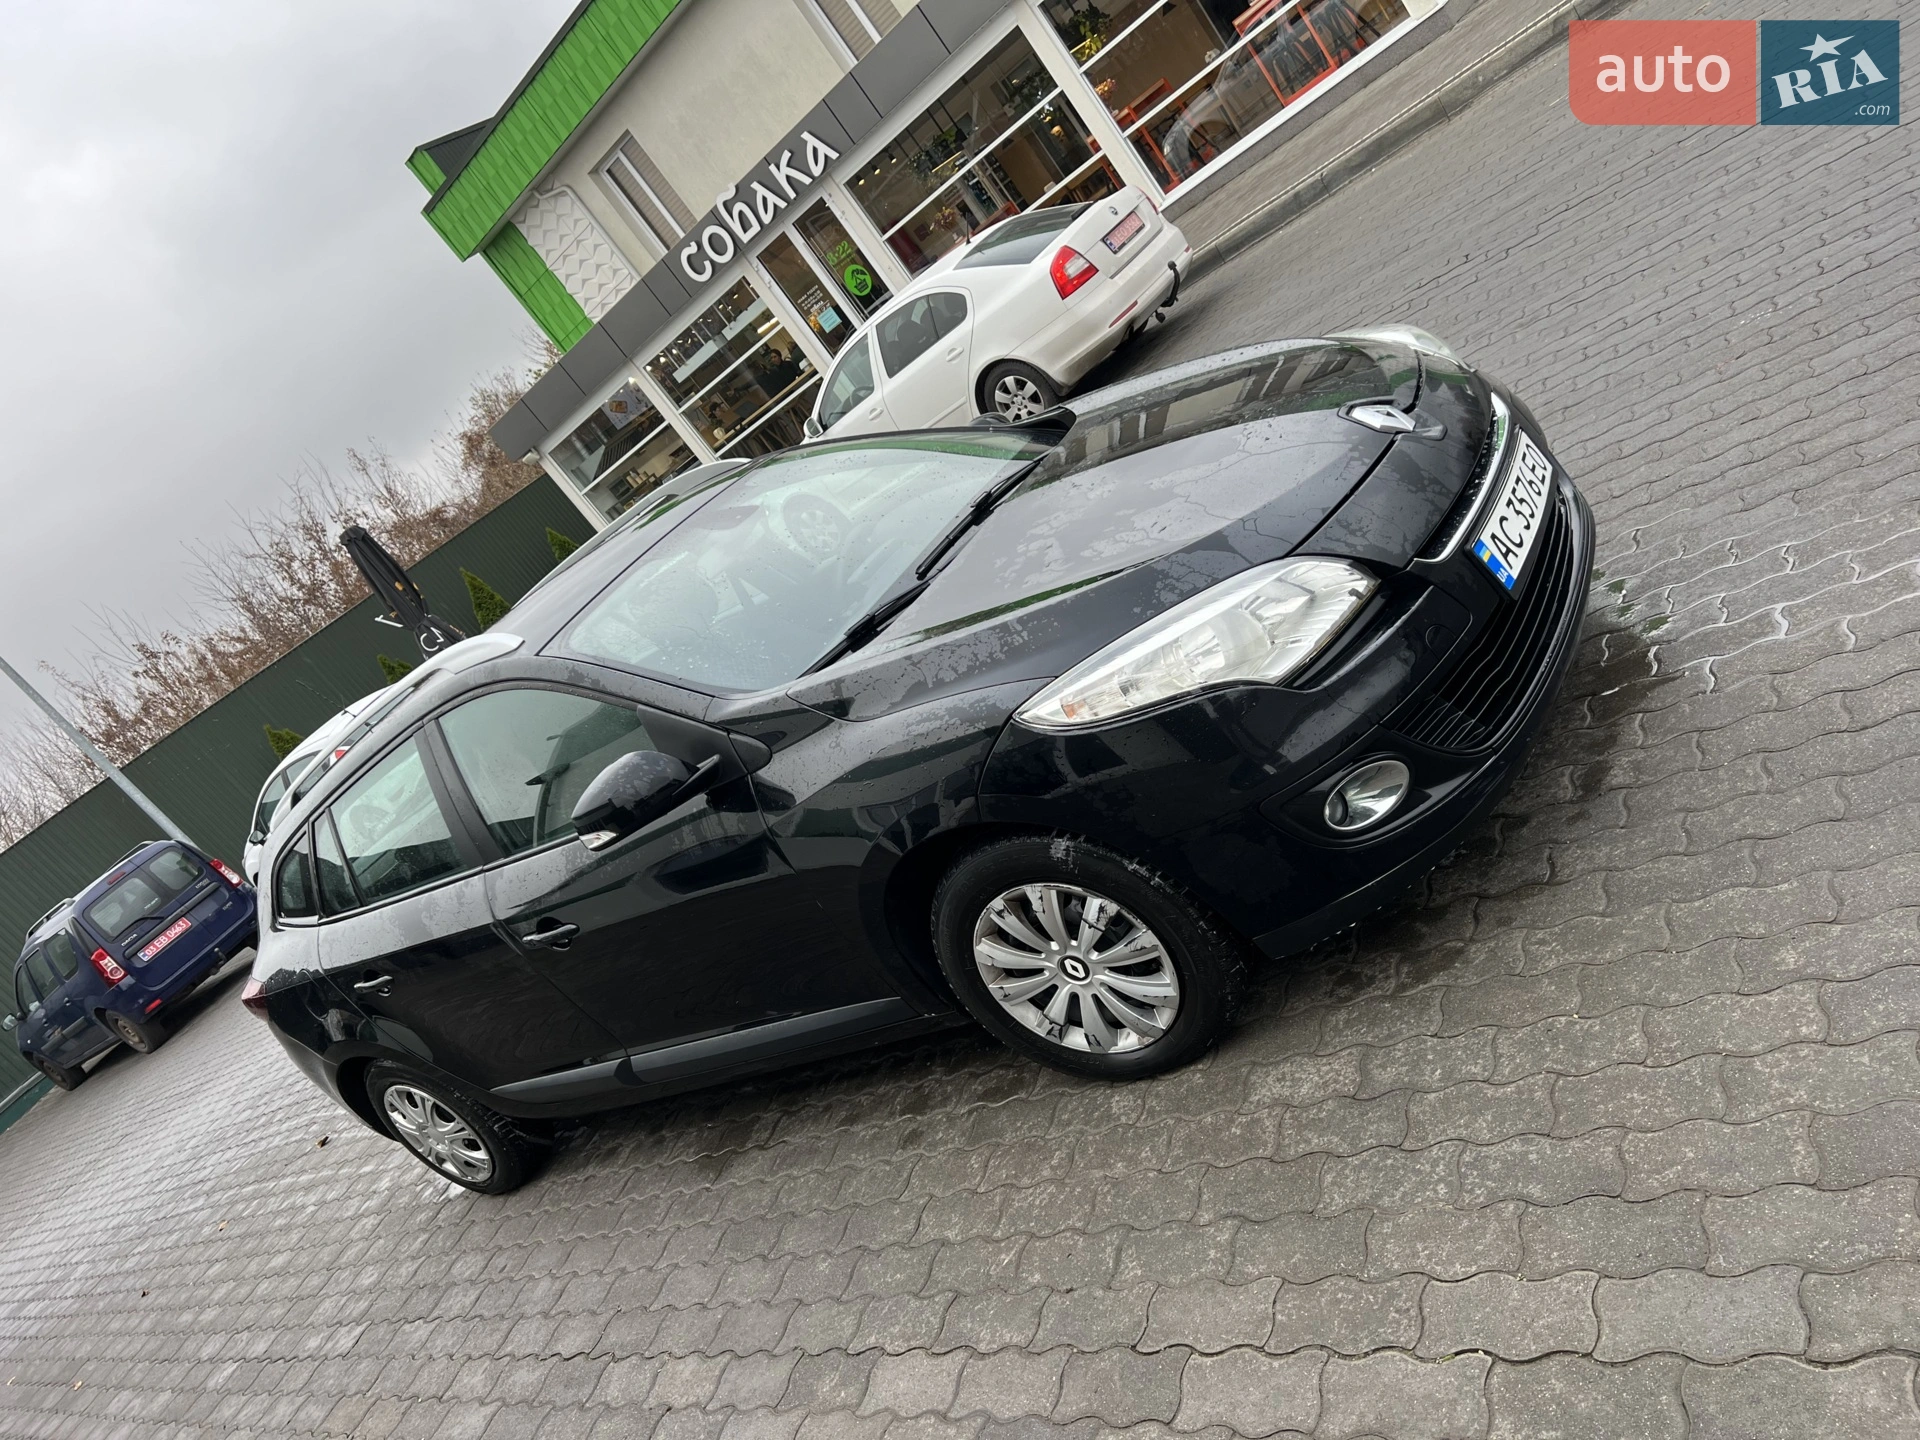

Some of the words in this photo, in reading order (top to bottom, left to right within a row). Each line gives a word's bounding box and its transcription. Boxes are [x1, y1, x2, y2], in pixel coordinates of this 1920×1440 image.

[681, 131, 840, 282] собака
[1522, 443, 1547, 486] EO
[1506, 466, 1542, 531] 3576
[1490, 515, 1523, 570] AC
[1497, 567, 1509, 583] UA
[145, 947, 155, 956] 03
[154, 936, 168, 948] EB
[166, 920, 187, 938] 0463
